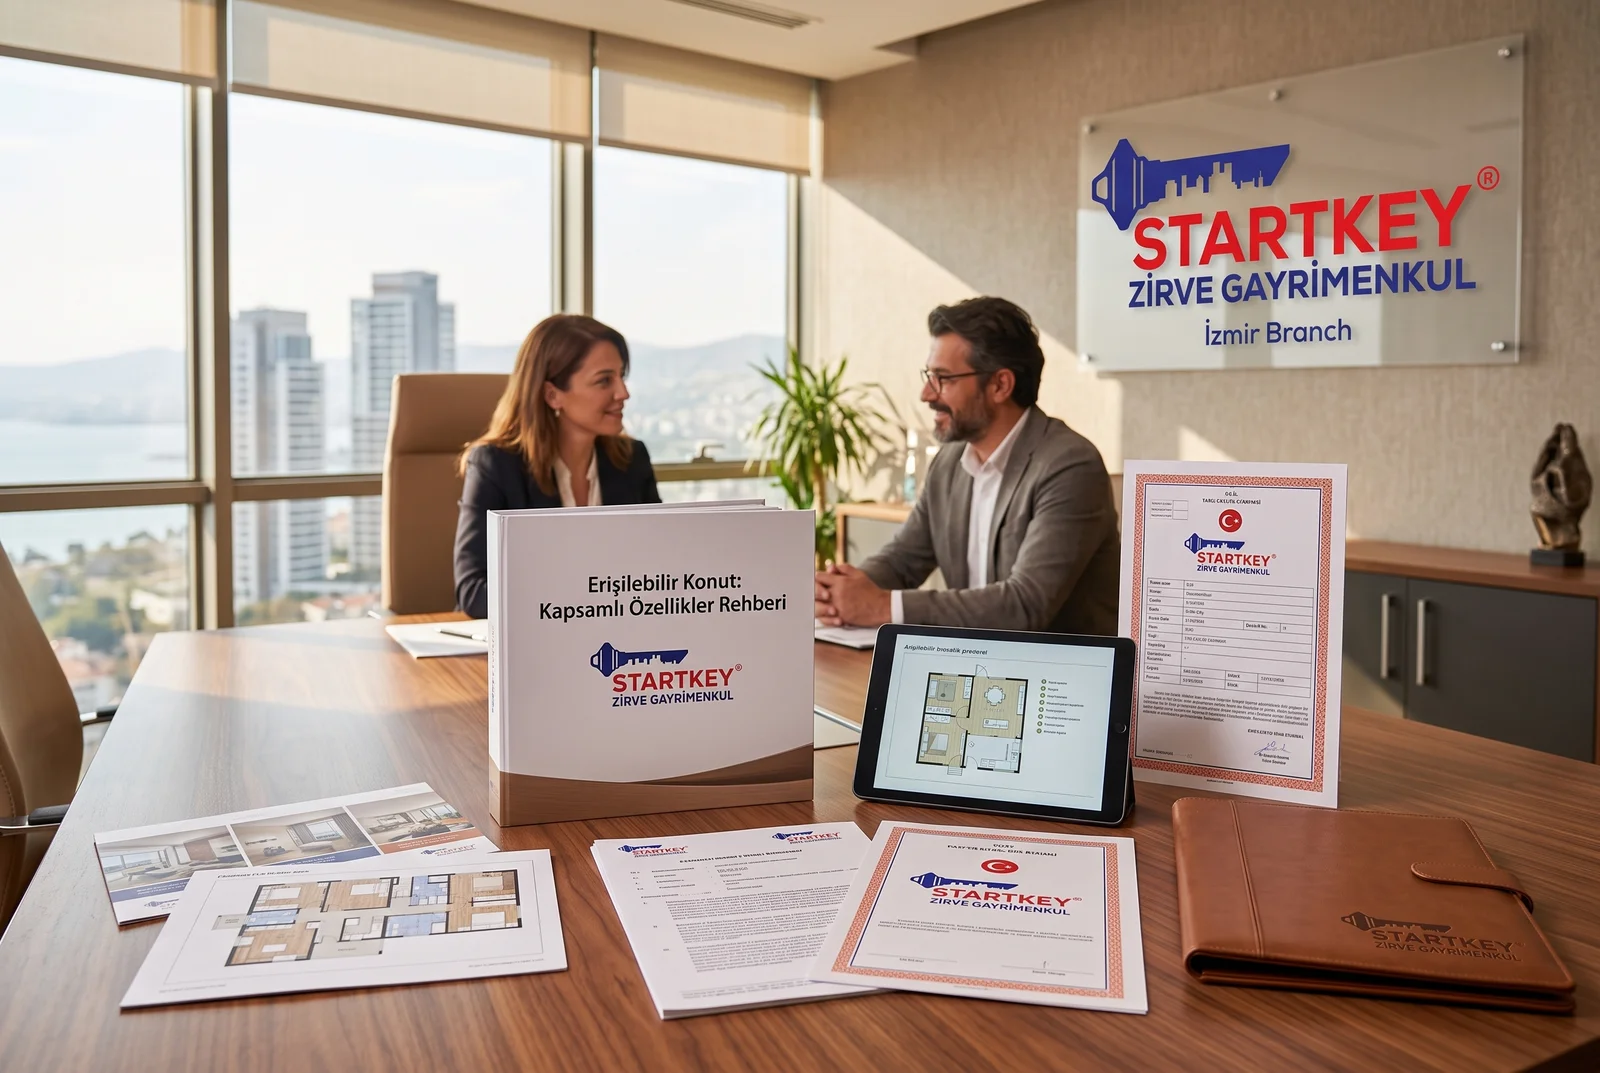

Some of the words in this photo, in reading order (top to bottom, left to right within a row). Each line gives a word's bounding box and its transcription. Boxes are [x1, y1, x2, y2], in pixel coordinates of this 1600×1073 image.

[1128, 271, 1213, 308] ZİRVE
[1221, 257, 1476, 302] GAYRİMENKUL
[1204, 318, 1260, 346] İzmir
[1265, 318, 1352, 343] Branch
[1196, 564, 1217, 572] ZİRVE
[1218, 566, 1270, 576] GAYRİMENKUL
[588, 574, 678, 597] Erişilebilir
[684, 573, 742, 590] Konut:
[540, 599, 624, 624] Kapsamlı
[629, 595, 715, 617] Özellikler
[719, 593, 787, 613] Rehberi
[612, 693, 647, 707] ZİRVE
[650, 690, 734, 705] GAYRİMENKUL
[971, 901, 1071, 916] GAYRİMENKUL
